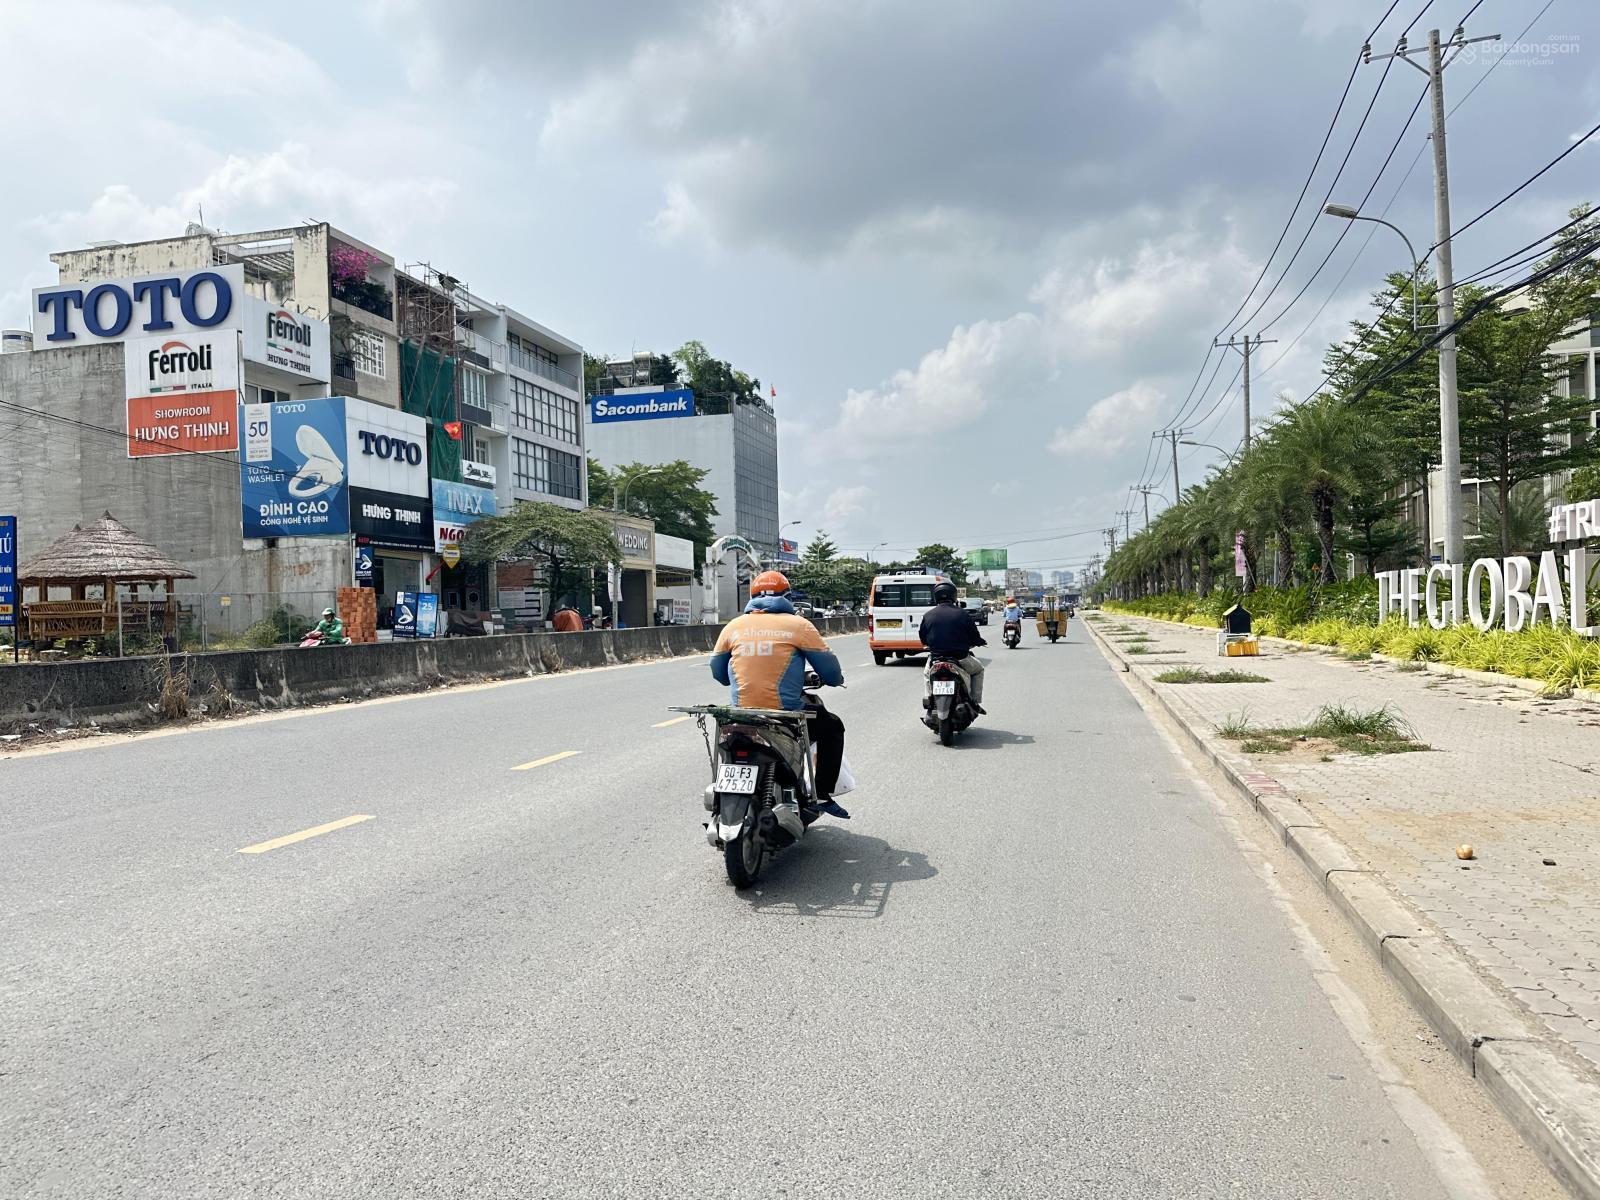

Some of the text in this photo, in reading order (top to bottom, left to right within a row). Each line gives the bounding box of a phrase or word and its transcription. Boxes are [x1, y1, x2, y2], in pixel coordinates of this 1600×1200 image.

[39, 272, 232, 341] TOTO
[267, 312, 311, 347] Ferroli
[149, 344, 212, 380] Ferroli
[155, 406, 211, 419] SHOWROOM
[276, 403, 306, 414] TOTO
[595, 396, 688, 417] Sacombank
[135, 421, 230, 442] HƯNG THỊNH
[248, 421, 268, 438] 50
[358, 430, 422, 466] TOTO
[248, 466, 270, 475] TOTO
[248, 474, 285, 484] WASHLET
[260, 499, 329, 516] ĐỈNH CAO
[447, 490, 484, 514] INAX
[260, 517, 281, 526] CÔNG
[282, 516, 302, 525] NGHỆ
[302, 515, 311, 525] VỆ
[394, 508, 421, 526] THỊNH
[617, 532, 648, 550] WEDDING
[724, 766, 752, 779] 60-F3
